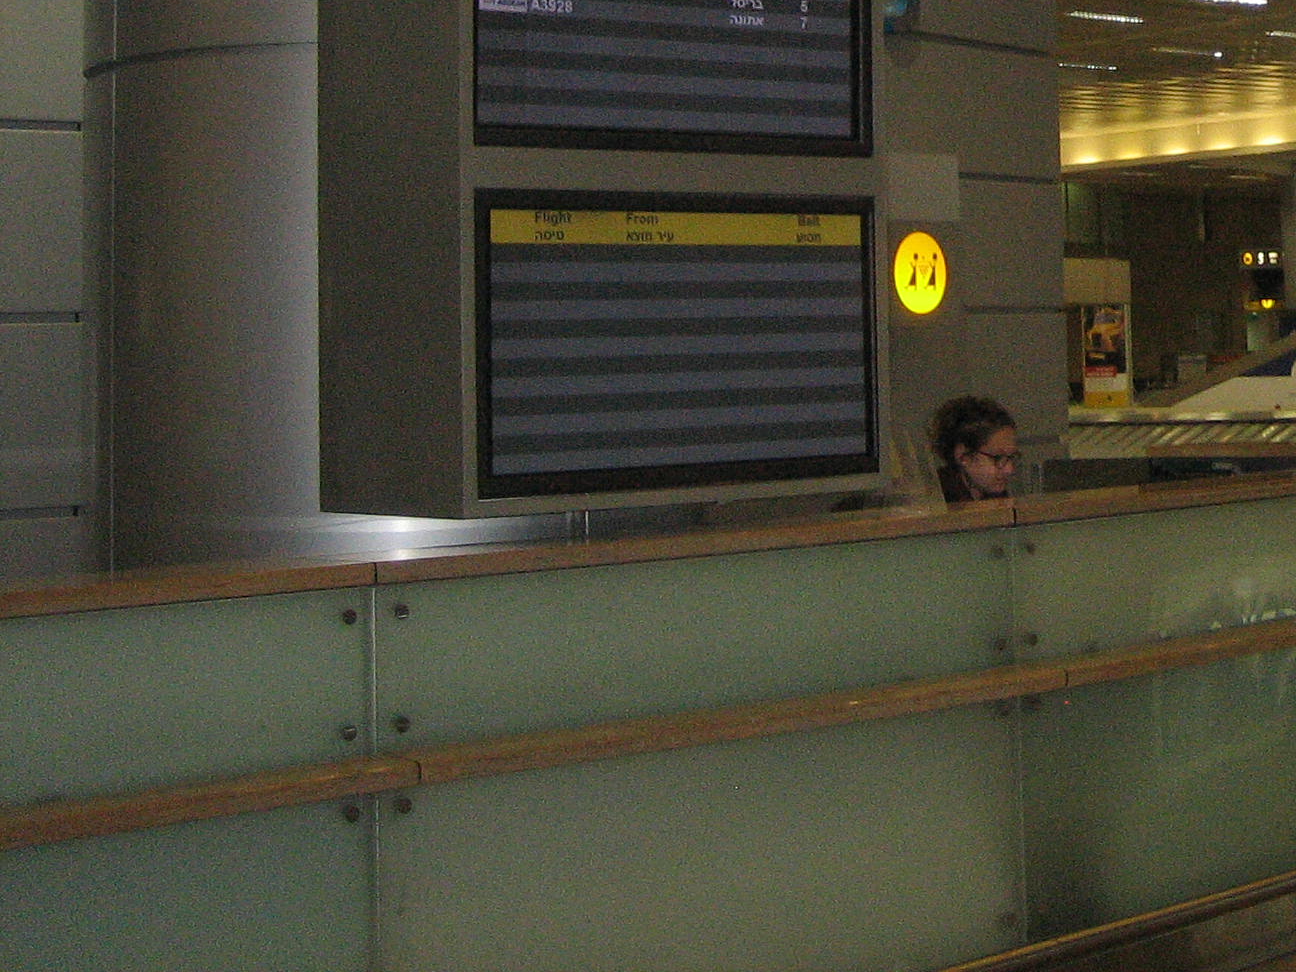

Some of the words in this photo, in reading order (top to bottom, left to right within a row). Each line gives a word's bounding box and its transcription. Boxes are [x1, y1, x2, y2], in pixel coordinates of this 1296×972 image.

[729, 14, 765, 26] אתונה
[535, 210, 572, 225] Flight
[625, 213, 659, 225] From
